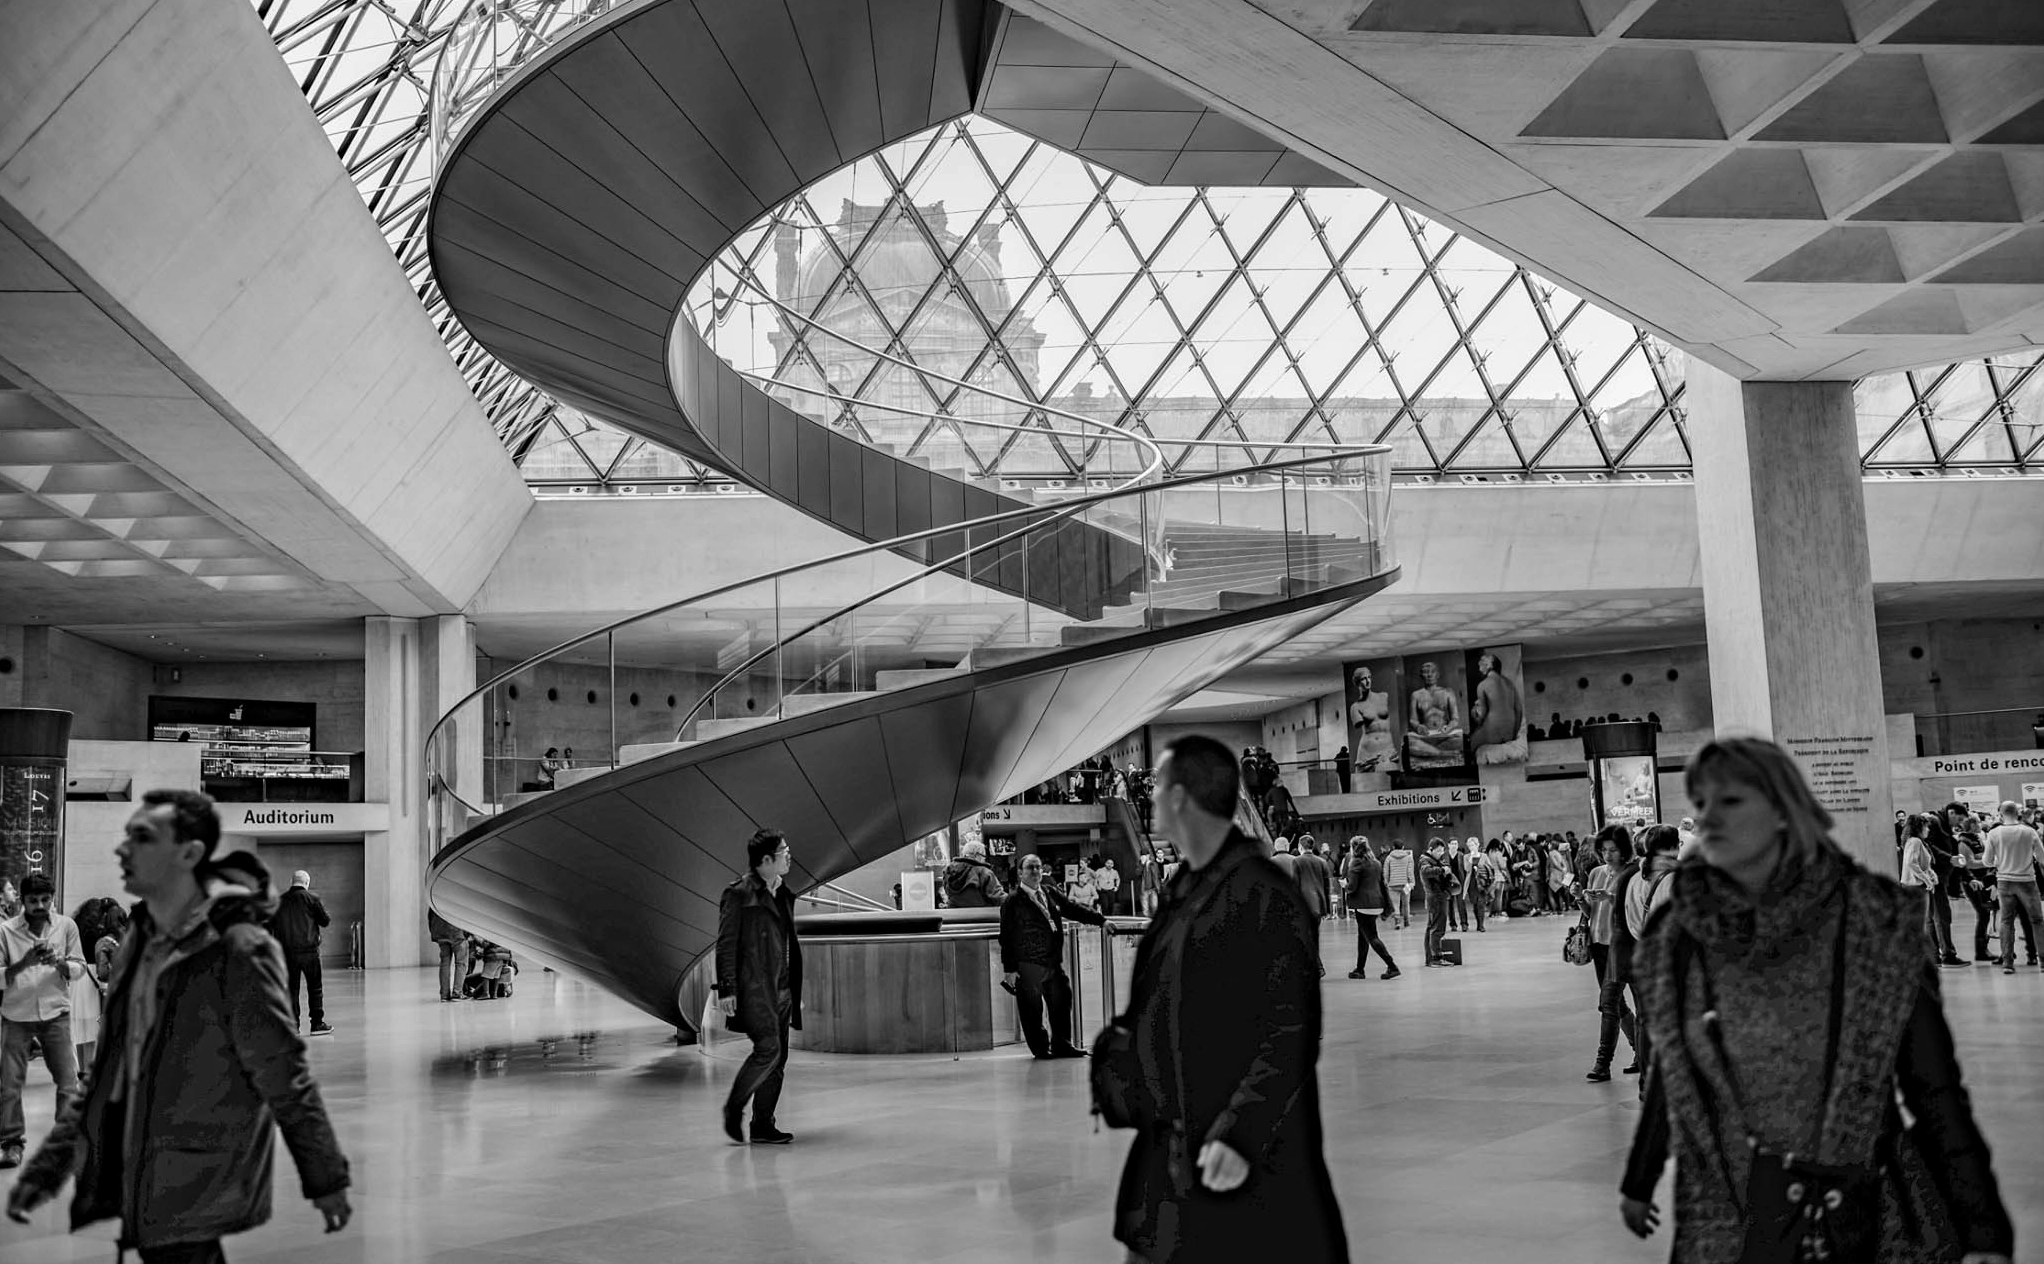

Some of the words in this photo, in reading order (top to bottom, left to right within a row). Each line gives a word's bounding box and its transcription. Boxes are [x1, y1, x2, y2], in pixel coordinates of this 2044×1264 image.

[1934, 760, 1975, 773] Point
[1980, 758, 1999, 770] de
[1377, 793, 1440, 806] Exhibitions
[243, 809, 335, 824] Auditorium
[983, 809, 1000, 819] ions
